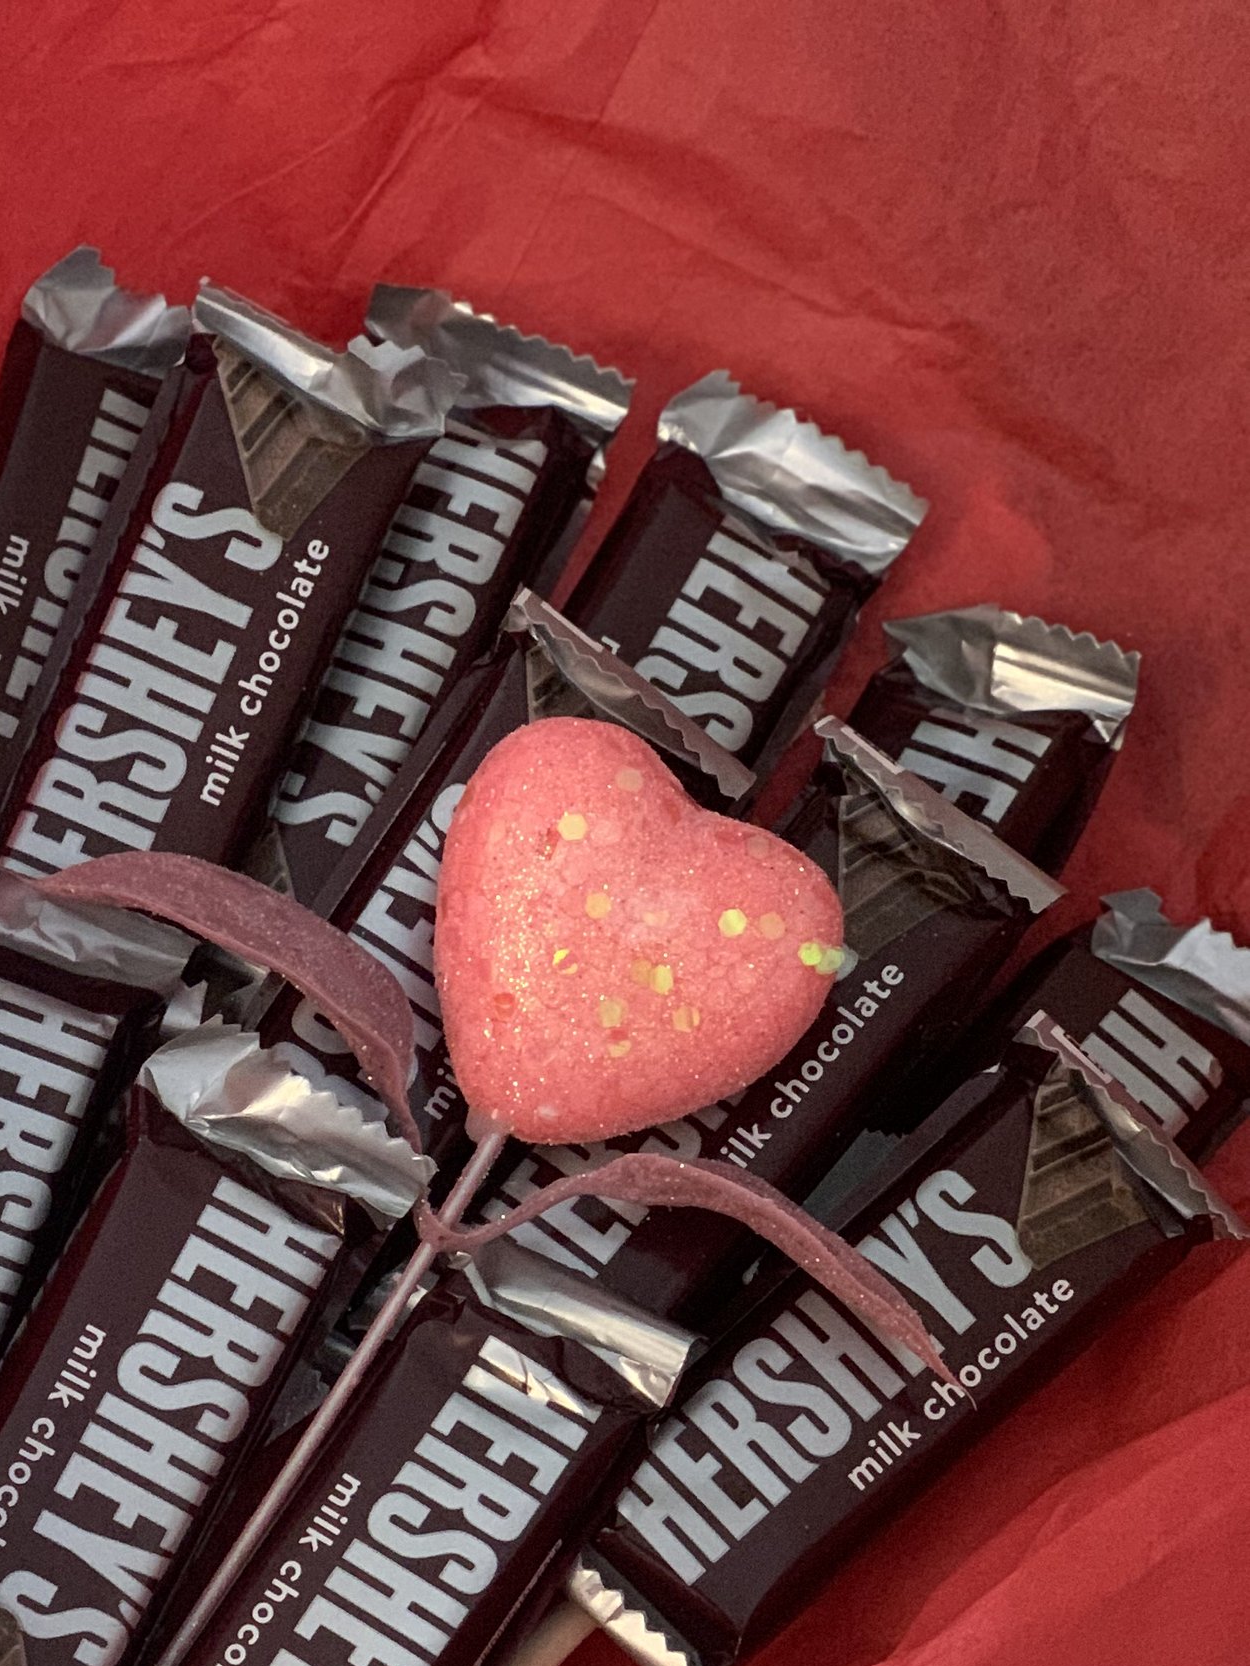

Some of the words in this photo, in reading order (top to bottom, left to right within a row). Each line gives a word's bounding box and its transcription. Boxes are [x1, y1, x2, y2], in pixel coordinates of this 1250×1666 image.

[0, 480, 284, 880] ERSHEY'S
[198, 722, 250, 807] milk
[240, 538, 331, 718] chocolate
[770, 963, 905, 1119] chocolate
[47, 1321, 108, 1409] milk
[617, 1169, 1032, 1586] HERSHY'S
[847, 1415, 922, 1491] milk
[923, 1274, 1075, 1422] chocolate
[297, 1472, 362, 1553] milk
